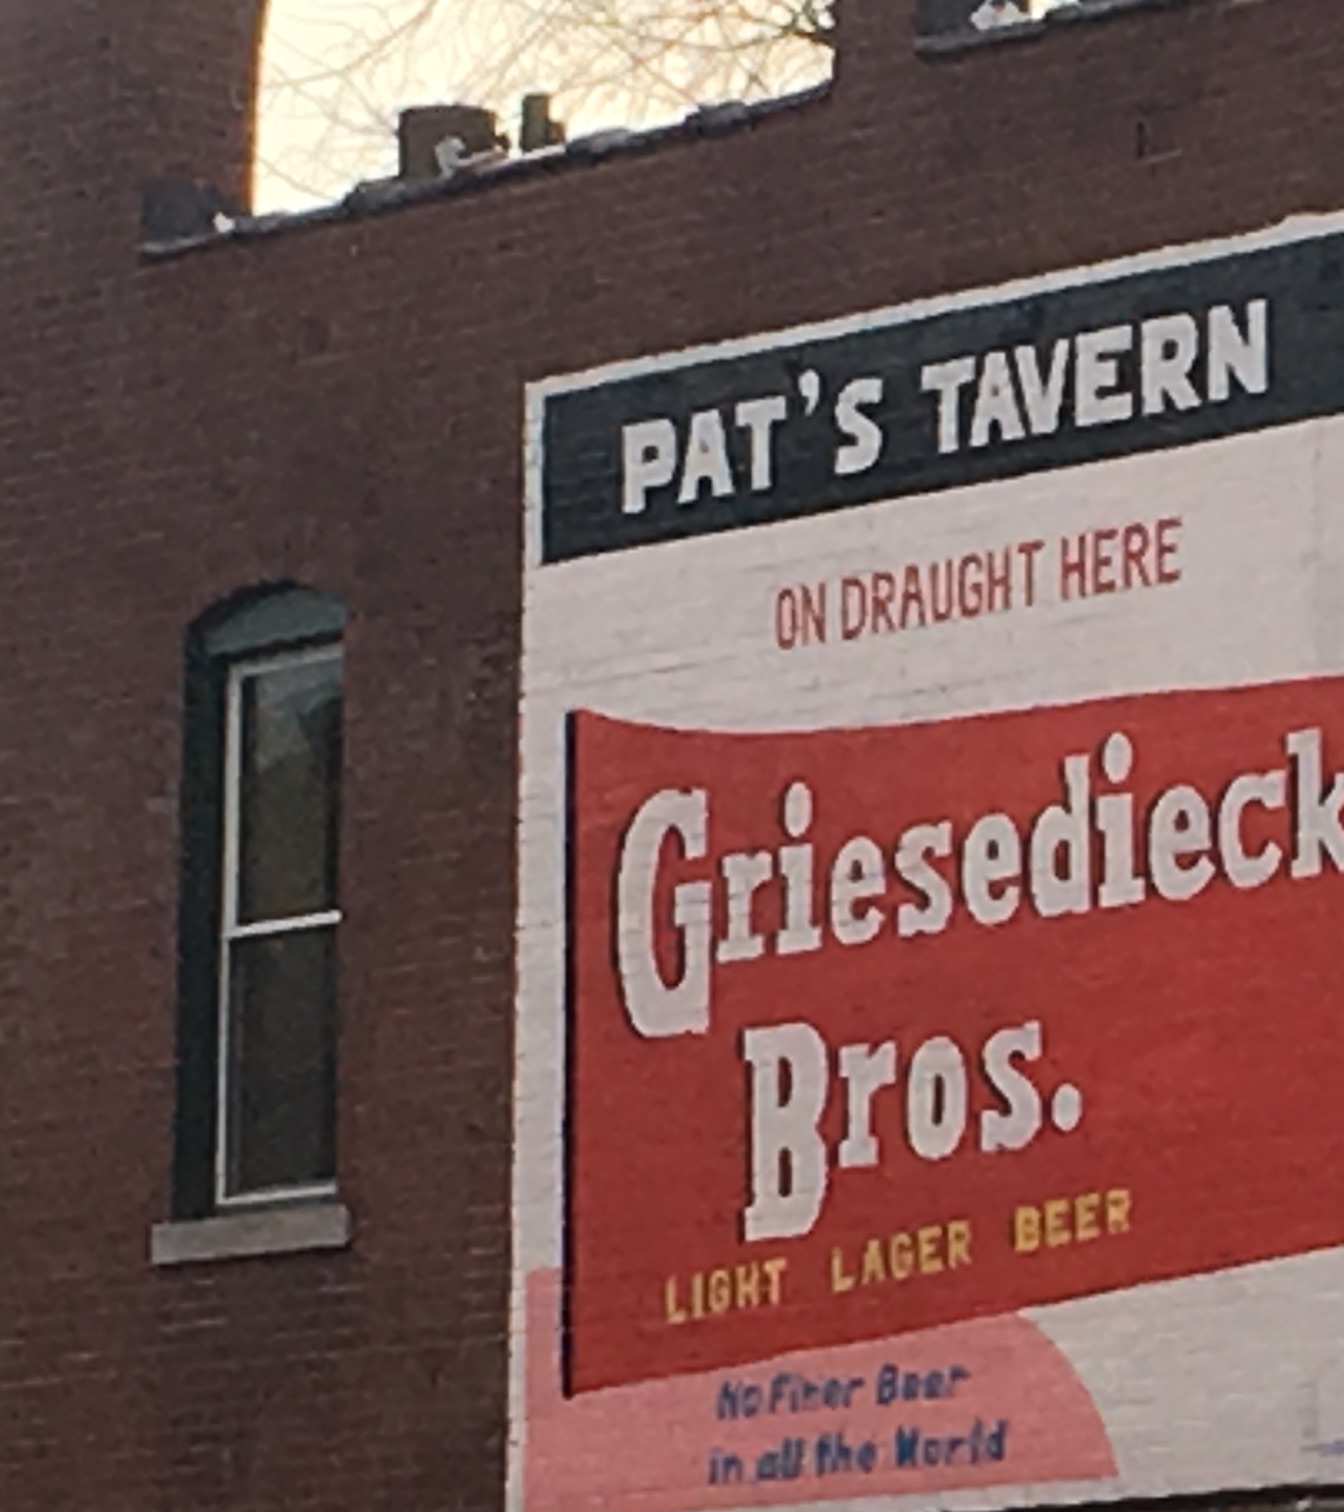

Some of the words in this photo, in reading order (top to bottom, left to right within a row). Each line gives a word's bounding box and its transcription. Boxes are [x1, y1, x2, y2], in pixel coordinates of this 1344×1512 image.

[620, 368, 884, 515] PAT'S
[920, 297, 1269, 455] TAVERN
[775, 579, 827, 652] ON
[840, 539, 1046, 643] DRAUGHT
[1059, 515, 1183, 601] HERE
[740, 1019, 1083, 1243] Bros.
[664, 1256, 788, 1325] LIGHT
[830, 1219, 973, 1292] LAGER
[1012, 1188, 1132, 1253] BEER
[707, 1446, 744, 1486] in
[755, 1435, 806, 1481] all
[814, 1430, 879, 1477] the
[894, 1417, 1010, 1468] World
[716, 1378, 761, 1420] No
[767, 1371, 866, 1414] Finer
[874, 1362, 971, 1407] Beer
